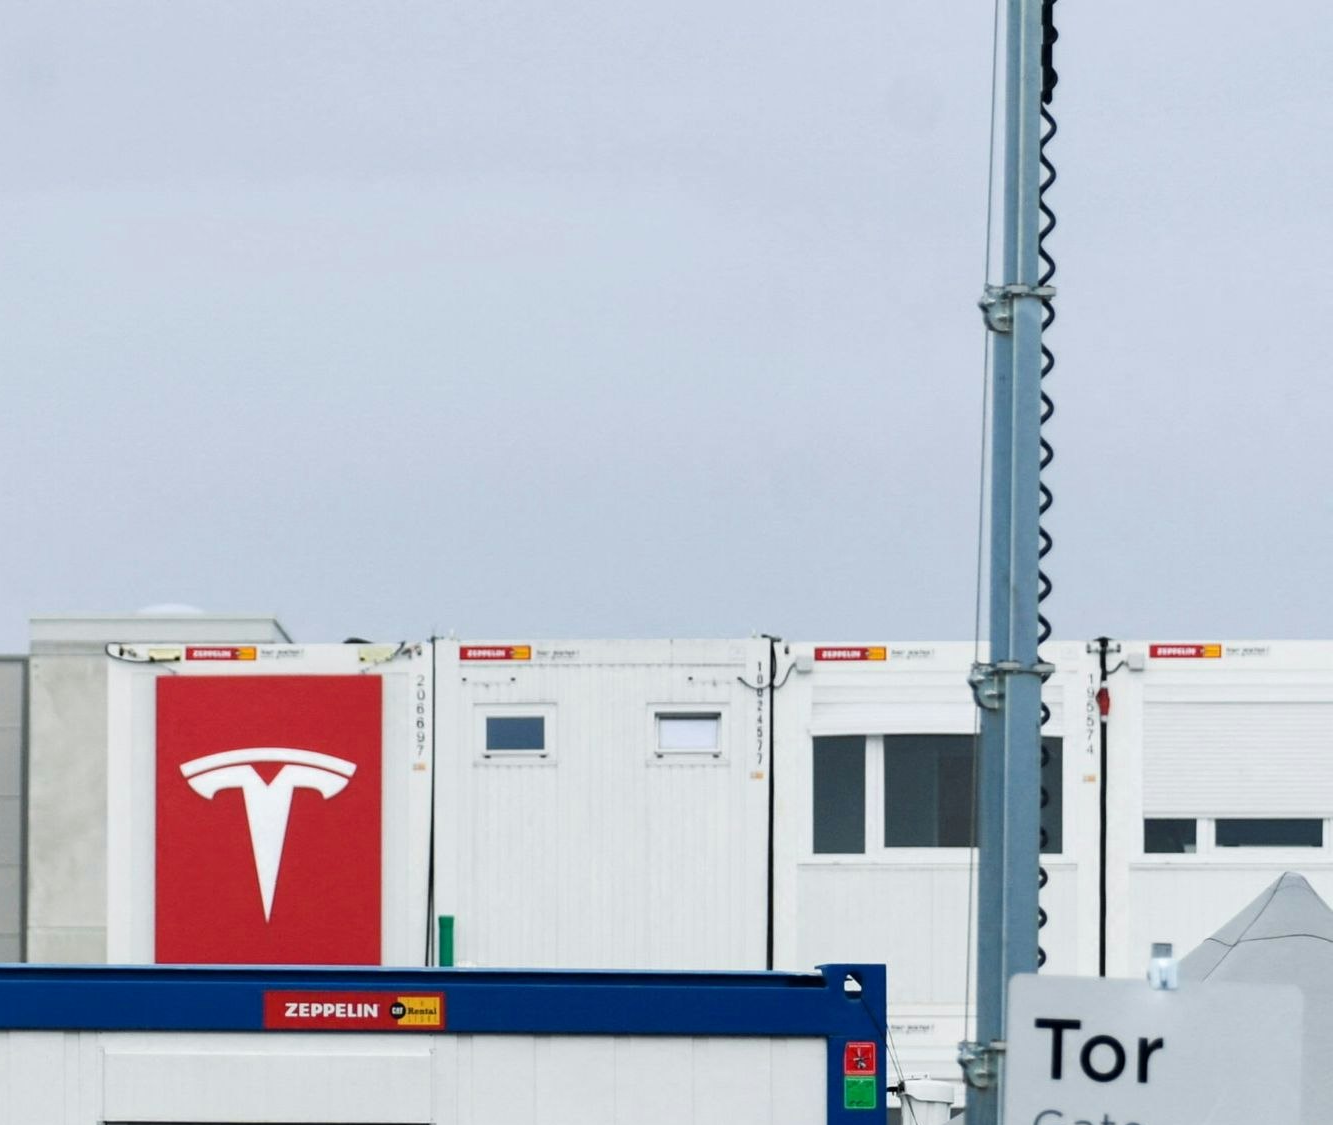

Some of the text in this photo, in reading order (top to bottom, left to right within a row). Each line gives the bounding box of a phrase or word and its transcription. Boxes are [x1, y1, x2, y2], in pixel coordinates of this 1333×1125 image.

[284, 1002, 379, 1018] ZEPPELIN
[407, 1007, 437, 1015] Rental
[1034, 1018, 1165, 1084] Tor
